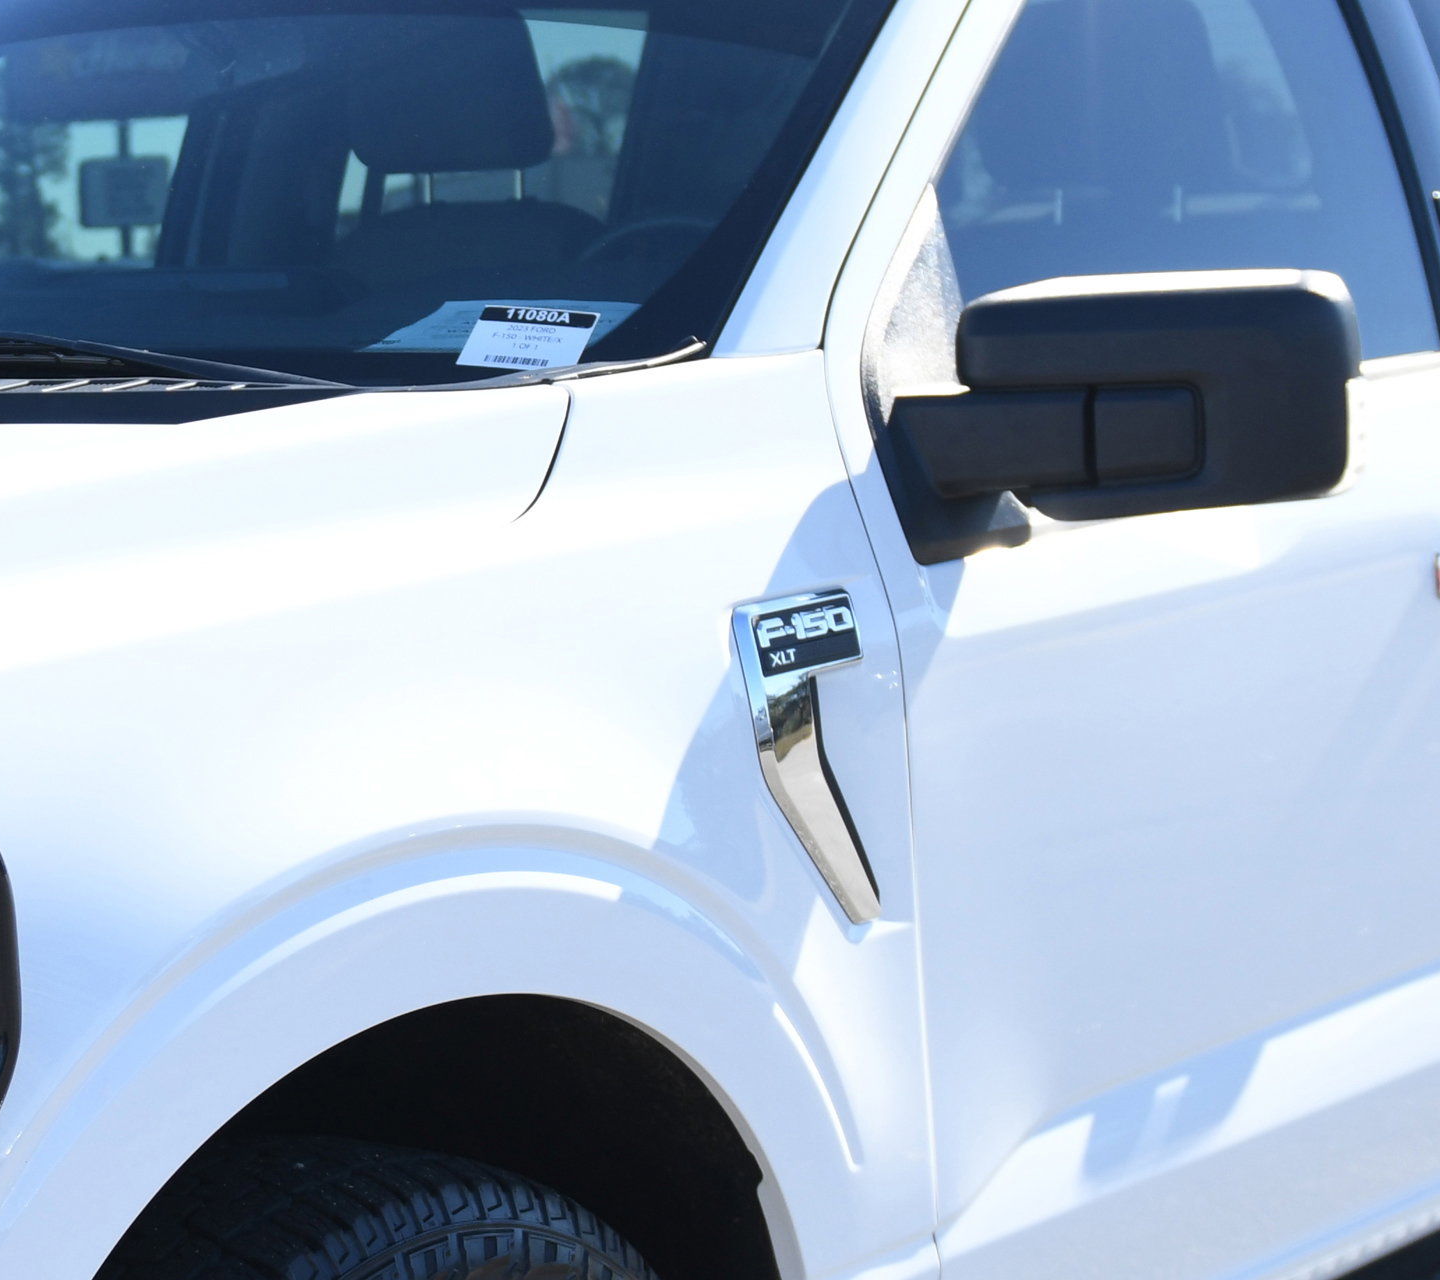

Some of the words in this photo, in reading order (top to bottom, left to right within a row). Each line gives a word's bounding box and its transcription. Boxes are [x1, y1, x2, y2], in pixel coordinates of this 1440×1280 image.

[506, 308, 570, 324] 11080A
[492, 332, 517, 340] F-150
[530, 326, 556, 334] FORD
[757, 606, 854, 648] F-150
[770, 648, 796, 667] XLT
